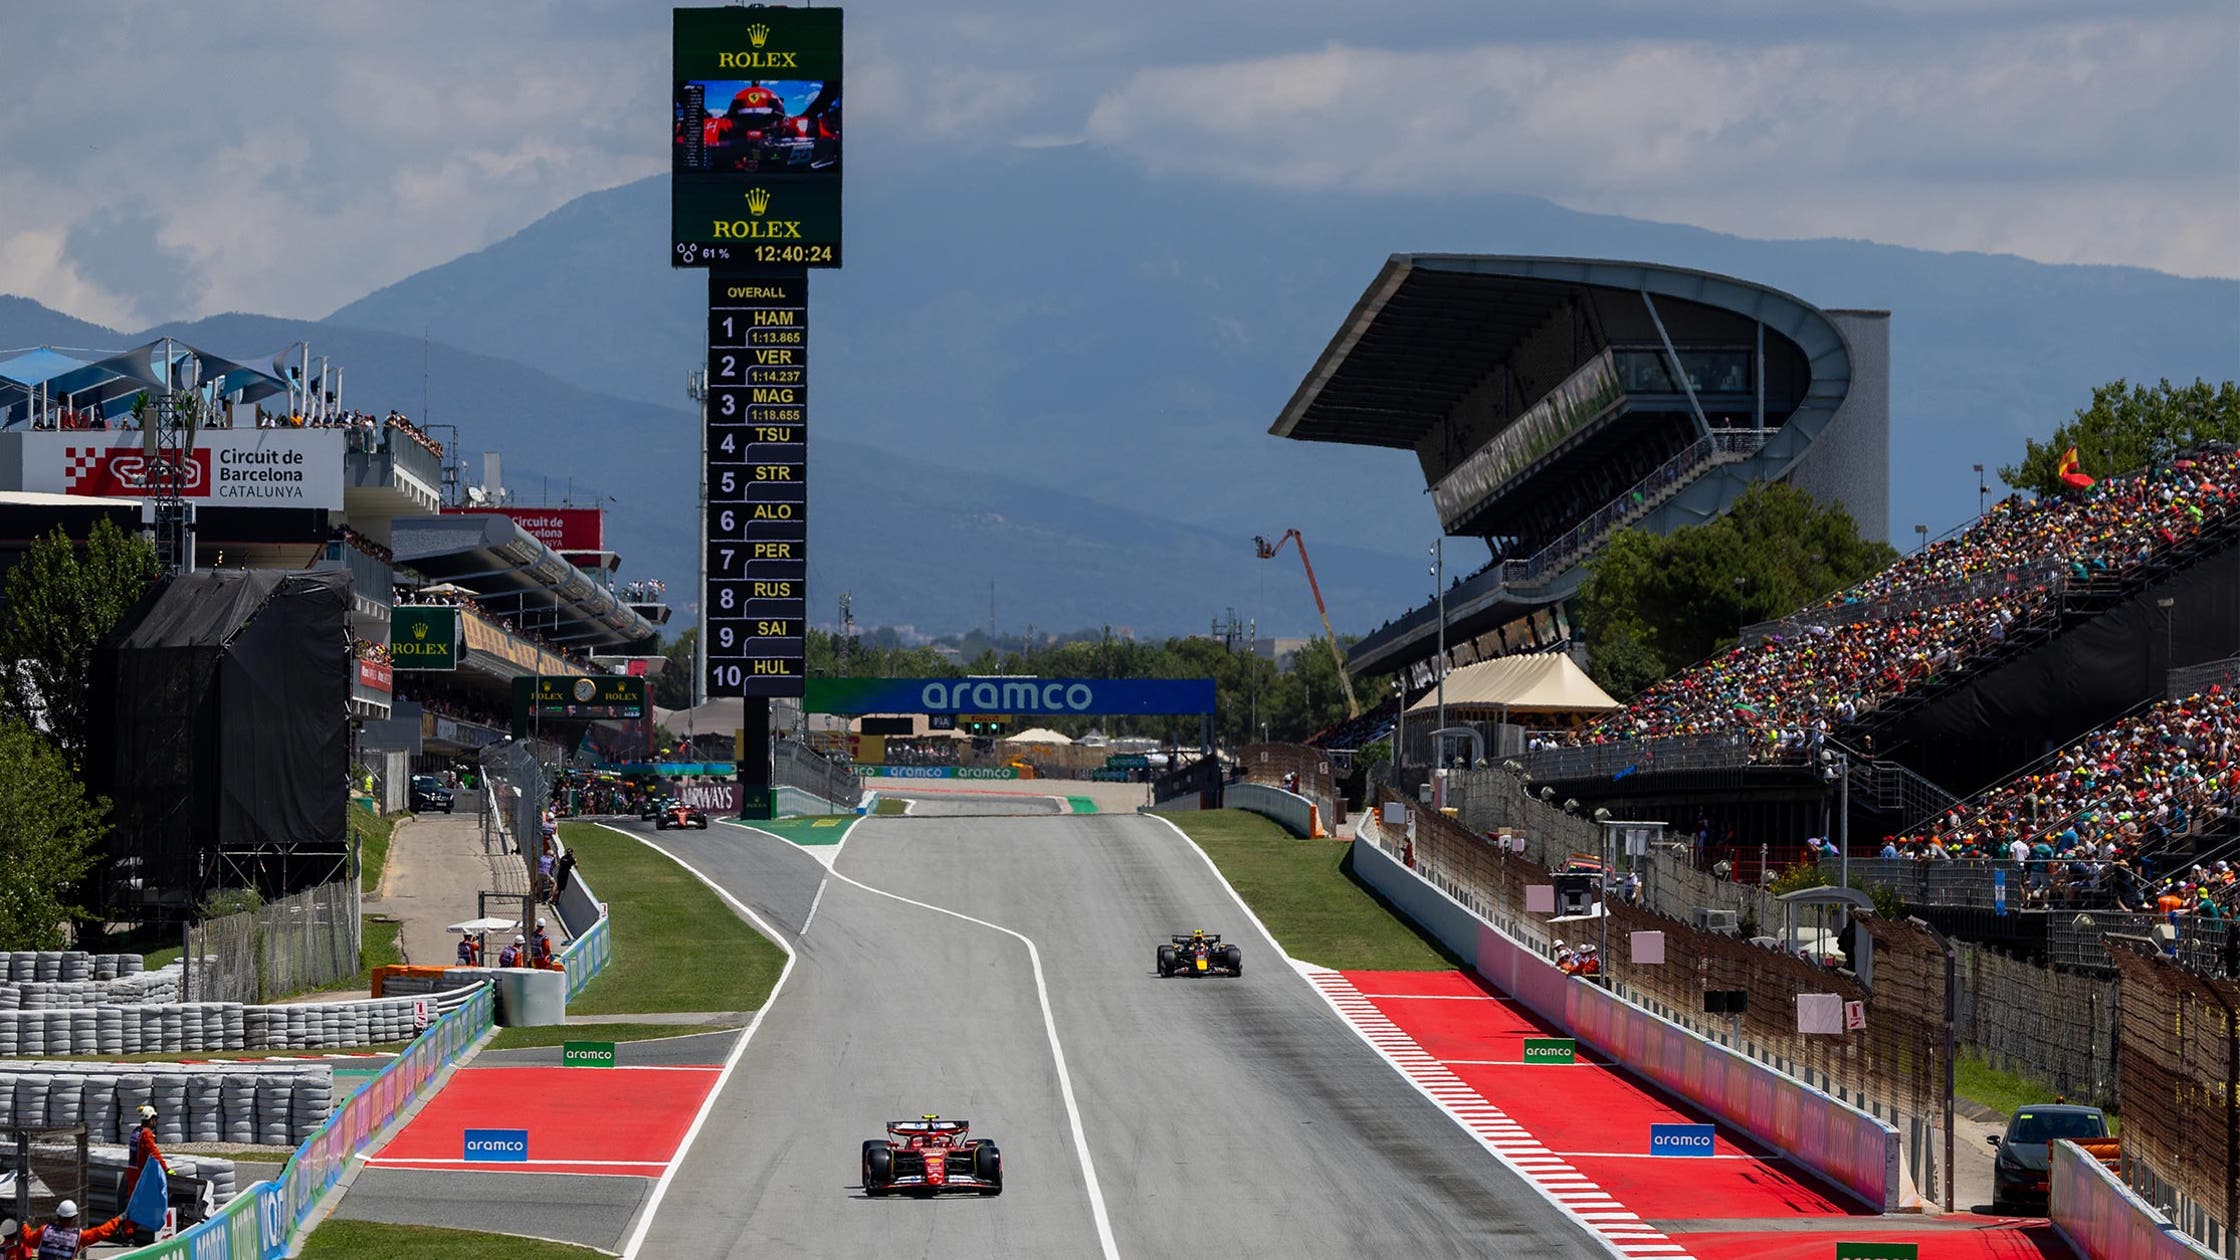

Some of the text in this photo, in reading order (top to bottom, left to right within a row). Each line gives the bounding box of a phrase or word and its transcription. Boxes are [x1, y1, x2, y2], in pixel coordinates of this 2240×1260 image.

[719, 51, 797, 68] ROLEX
[713, 220, 800, 239] ROLEX
[702, 248, 730, 259] 61 %
[755, 245, 832, 263] 12:40:24
[727, 286, 786, 298] OVERALL
[722, 310, 794, 338] 1 HAM
[752, 332, 801, 343] 1:13.865
[720, 349, 792, 377] 2 VER
[751, 370, 801, 382] 1:14.237
[721, 388, 794, 415] 3 MAG
[751, 409, 800, 421] 1:18.655
[720, 427, 791, 454] 4 TSU
[219, 447, 304, 465] Circuit de
[220, 467, 303, 482] Barcelona
[721, 465, 791, 493] 5 STR
[219, 485, 303, 498] CATALUNYA
[550, 517, 563, 527] de
[720, 504, 792, 532] 6 ALO
[530, 529, 563, 538] celona
[720, 543, 791, 570] 7 PER
[720, 582, 791, 609] 8 RUS
[719, 620, 787, 648] 9 SAI
[392, 643, 448, 655] ROLEX
[713, 659, 790, 687] 10 HUL
[605, 692, 637, 700] ROLEX
[921, 682, 1093, 711] aramco
[890, 766, 942, 777] aramco
[958, 768, 1011, 778] aramco
[566, 1050, 612, 1060] aramco
[1526, 1047, 1572, 1057] aramco
[467, 1140, 524, 1152] aramco
[1654, 1135, 1711, 1146] aramco
